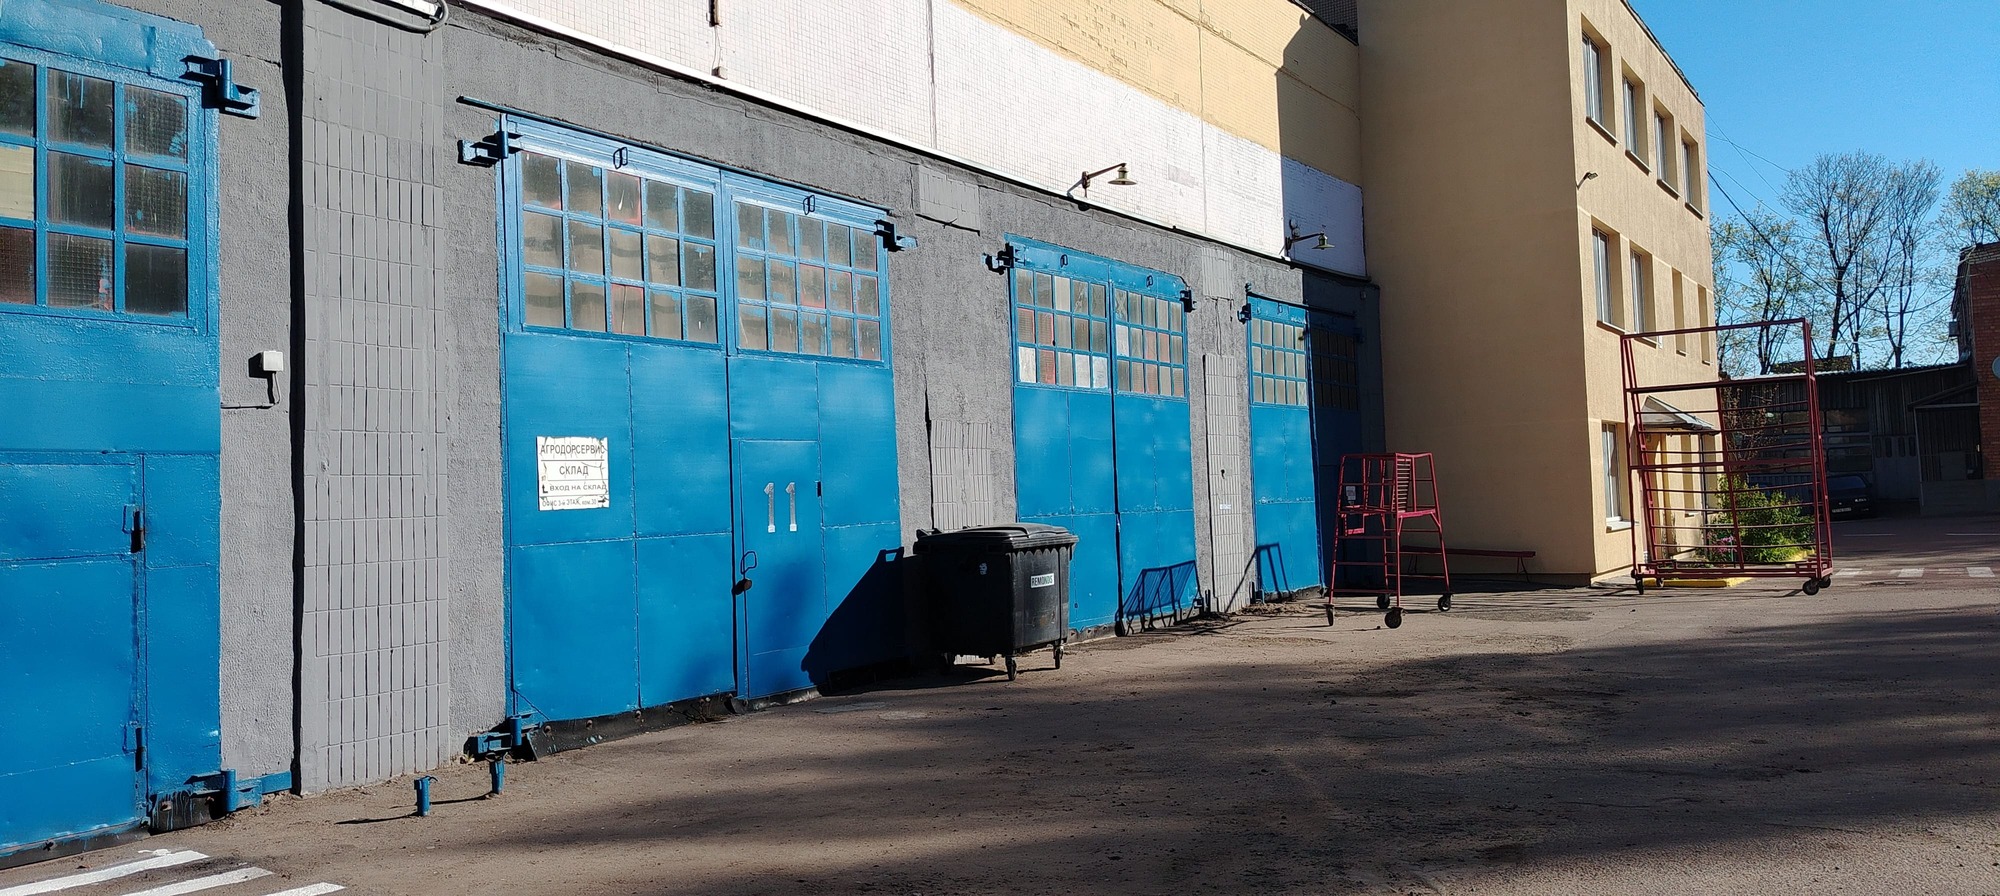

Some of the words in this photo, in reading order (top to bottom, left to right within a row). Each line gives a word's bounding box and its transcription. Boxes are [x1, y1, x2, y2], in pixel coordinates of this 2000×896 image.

[541, 444, 605, 454] АГРОДОРСЕРВИС
[559, 465, 589, 476] СКЛАД
[762, 481, 797, 533] 11
